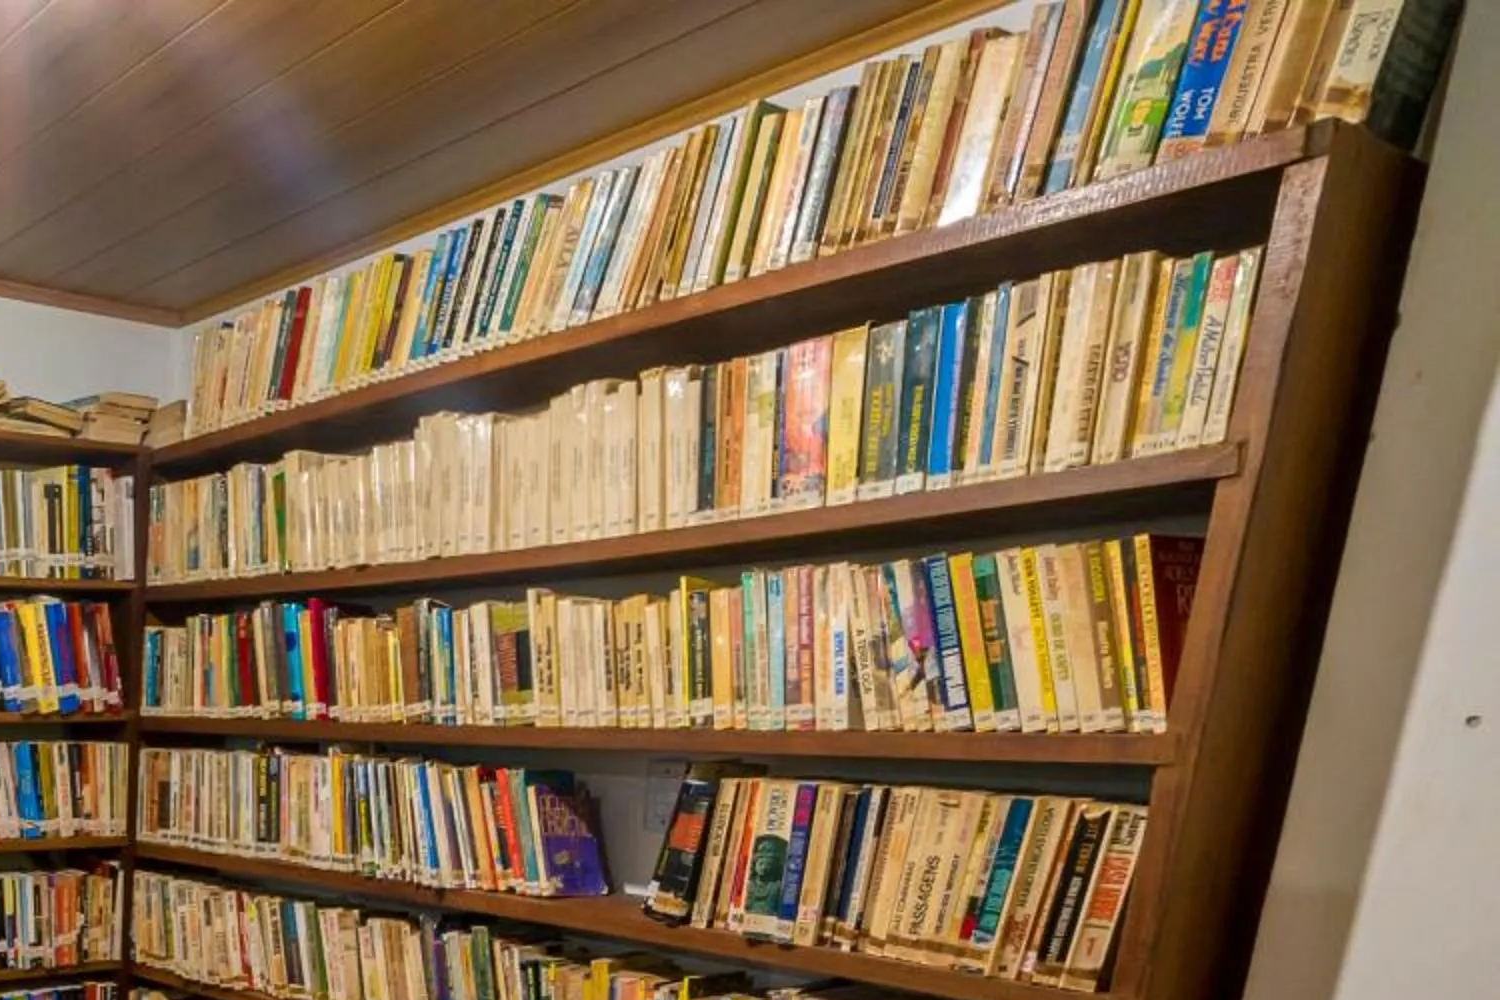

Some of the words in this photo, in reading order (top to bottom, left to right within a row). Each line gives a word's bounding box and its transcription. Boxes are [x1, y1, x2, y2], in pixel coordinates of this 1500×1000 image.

[1193, 87, 1215, 121] TOM
[858, 638, 870, 670] TERRA
[862, 672, 873, 695] OCA
[907, 854, 942, 936] PASSAGENS
